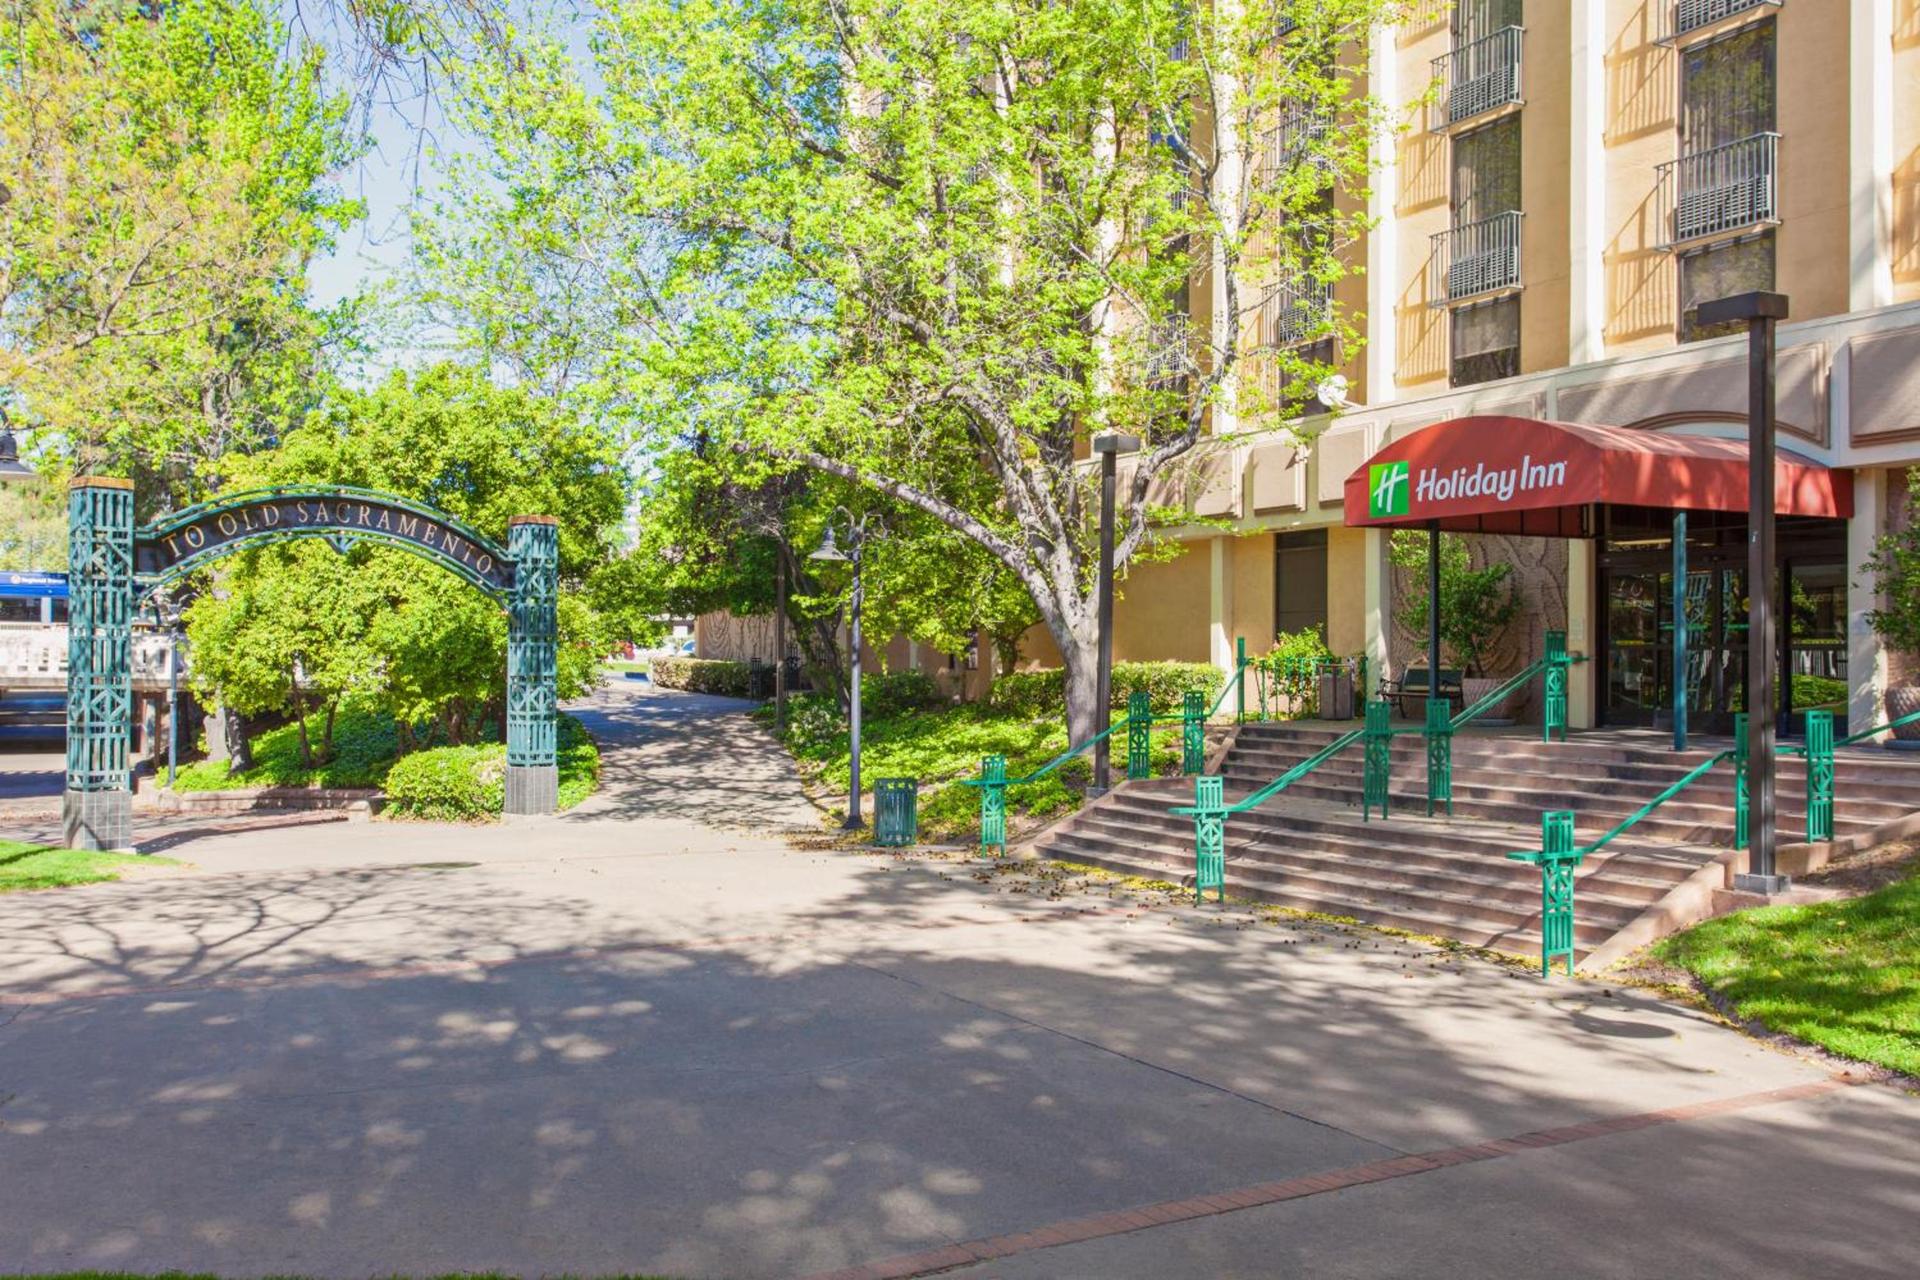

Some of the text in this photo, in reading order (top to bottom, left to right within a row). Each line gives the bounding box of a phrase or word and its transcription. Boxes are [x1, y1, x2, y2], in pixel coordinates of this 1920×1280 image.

[1416, 455, 1566, 501] Holiday Inn
[161, 500, 492, 574] TO OLD SACRAMENTO
